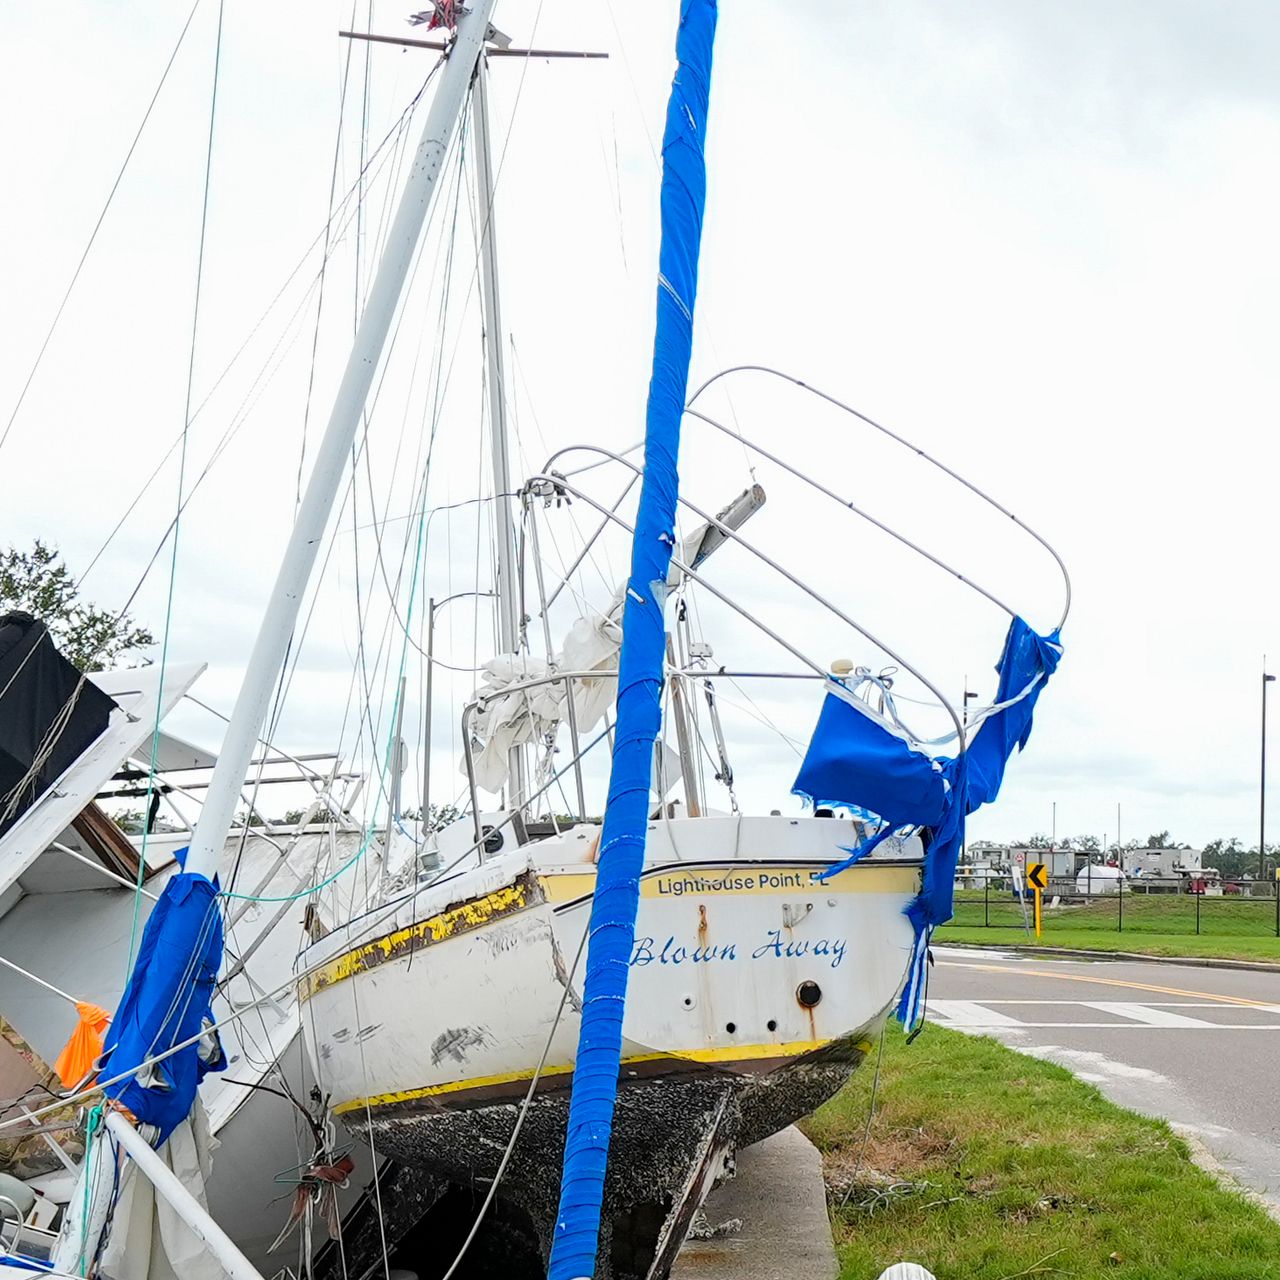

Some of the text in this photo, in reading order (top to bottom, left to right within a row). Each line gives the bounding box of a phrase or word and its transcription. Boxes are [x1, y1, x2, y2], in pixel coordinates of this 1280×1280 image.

[658, 877, 754, 896] Lighthouse
[759, 872, 805, 889] Point,
[630, 929, 848, 968] Blown Away
